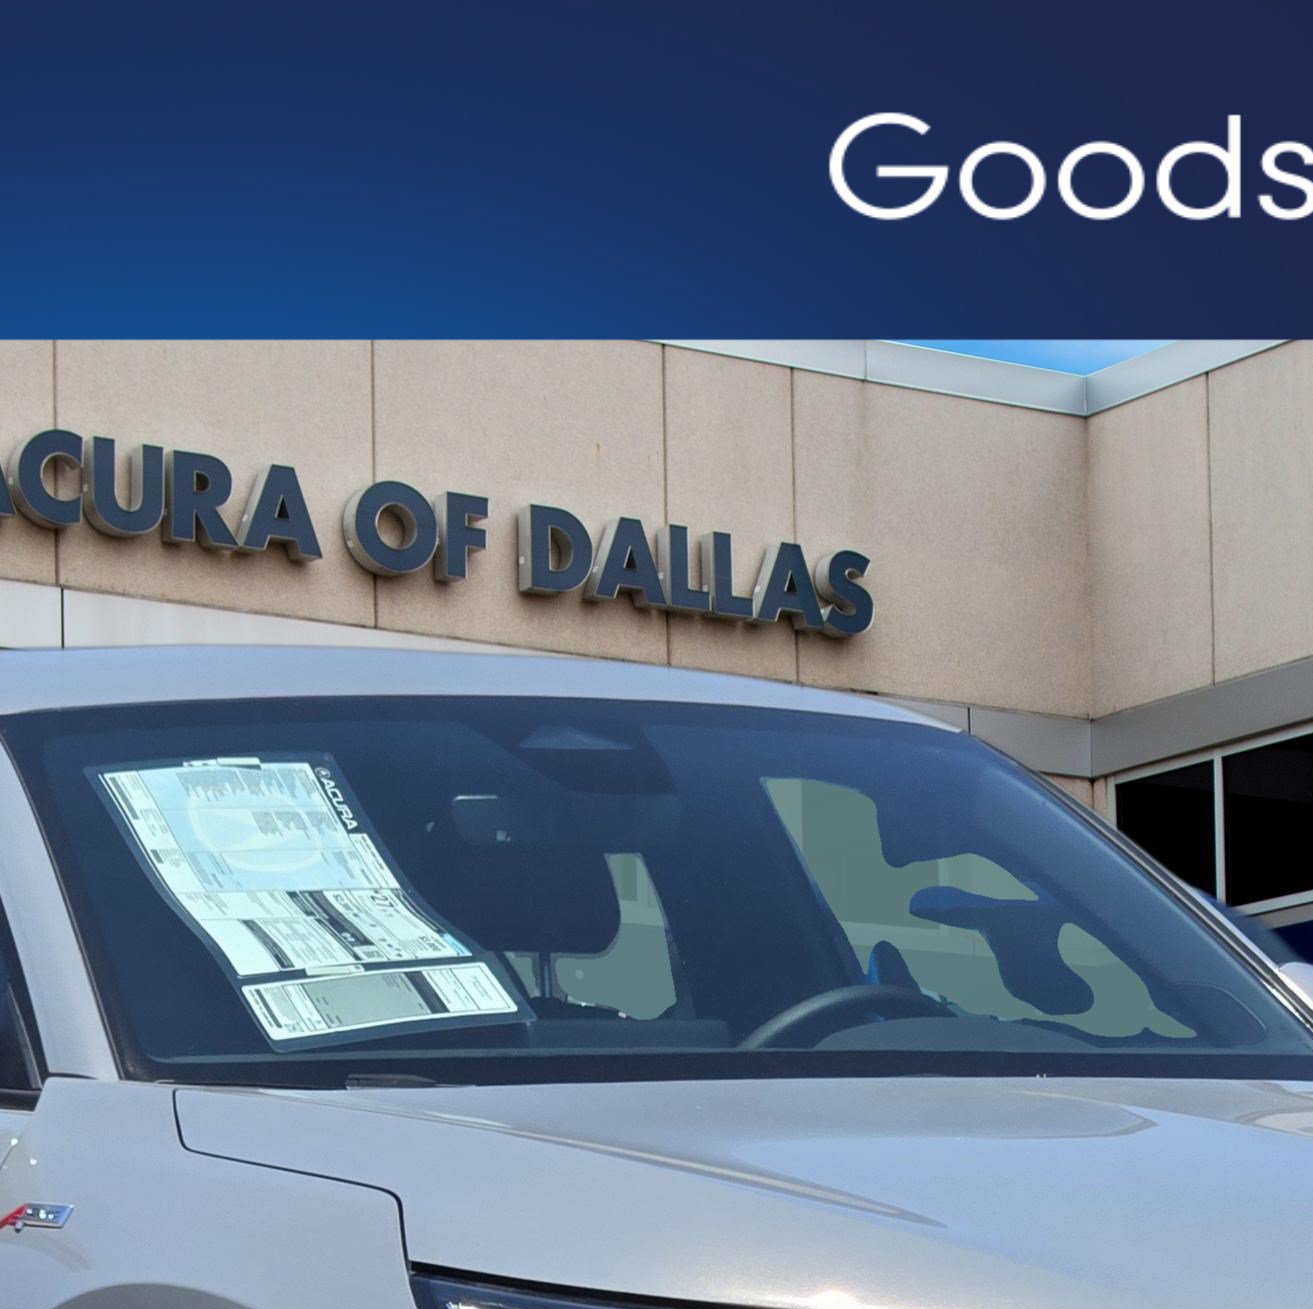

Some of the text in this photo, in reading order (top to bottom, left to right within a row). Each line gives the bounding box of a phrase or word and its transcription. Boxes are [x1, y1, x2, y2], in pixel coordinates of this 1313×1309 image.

[344, 480, 488, 582] OF
[518, 503, 875, 638] DALLAS
[321, 778, 358, 830] ACURA
